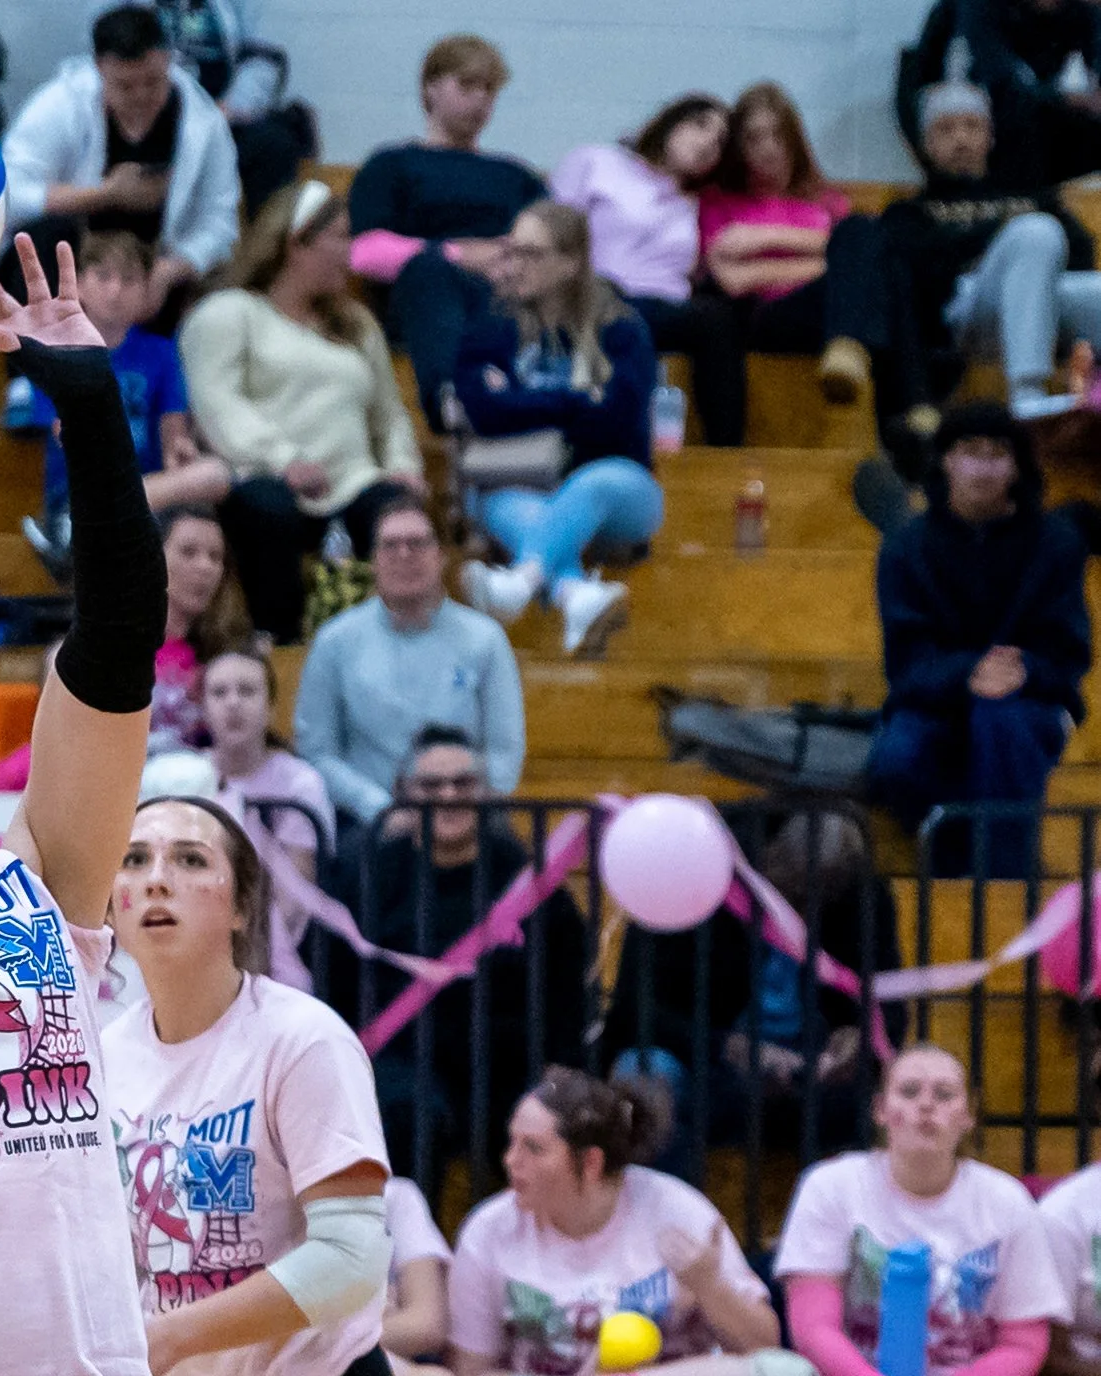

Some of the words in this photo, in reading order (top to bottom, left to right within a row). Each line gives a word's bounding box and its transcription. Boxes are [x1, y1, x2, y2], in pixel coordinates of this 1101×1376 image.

[186, 1098, 255, 1145] MOTT
[4, 1135, 46, 1155] UNITED
[49, 1134, 65, 1150] FOR
[68, 1133, 75, 1149] A
